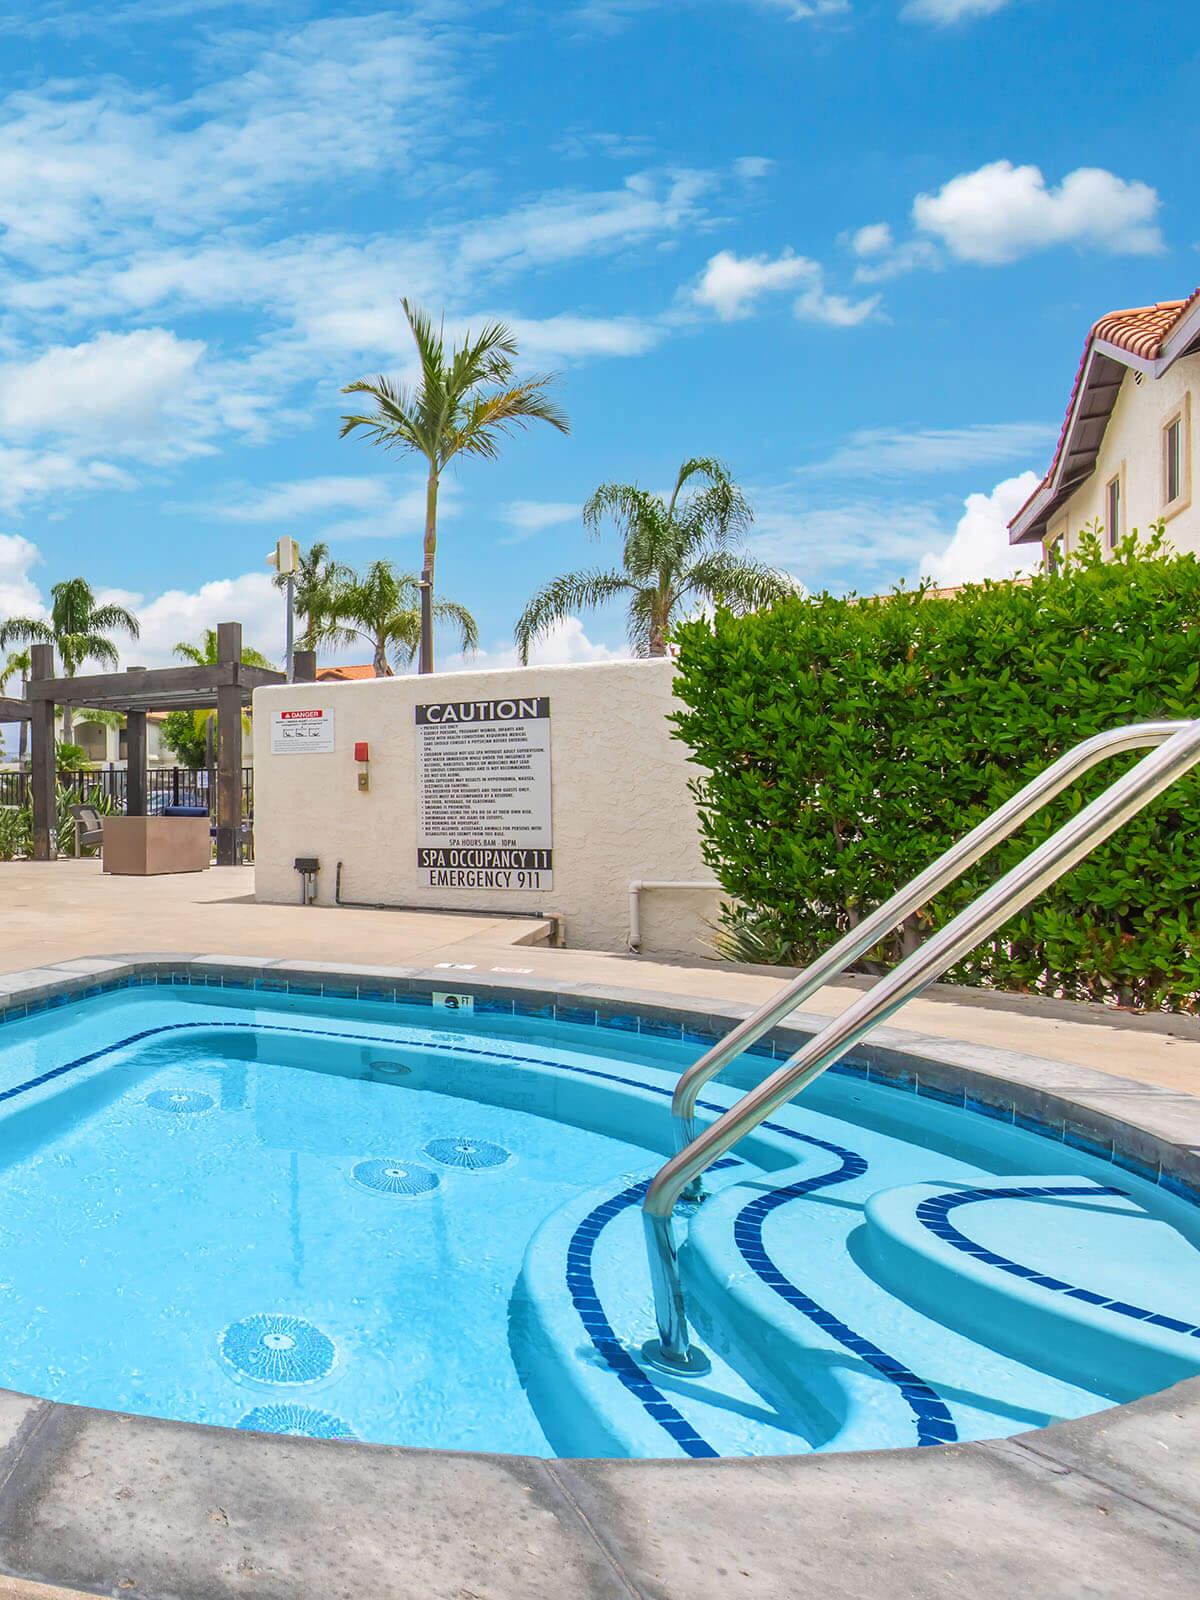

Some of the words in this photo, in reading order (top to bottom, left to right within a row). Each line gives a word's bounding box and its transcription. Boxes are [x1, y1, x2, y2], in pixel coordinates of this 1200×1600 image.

[426, 700, 538, 723] CAUTION
[484, 839, 496, 847] 8AM
[502, 839, 516, 847] 10PM
[422, 849, 446, 866] SPA
[449, 850, 527, 868] OCCUPANCY
[533, 851, 548, 868] 11
[430, 870, 512, 888] EMERGENCY
[517, 871, 540, 889] 911
